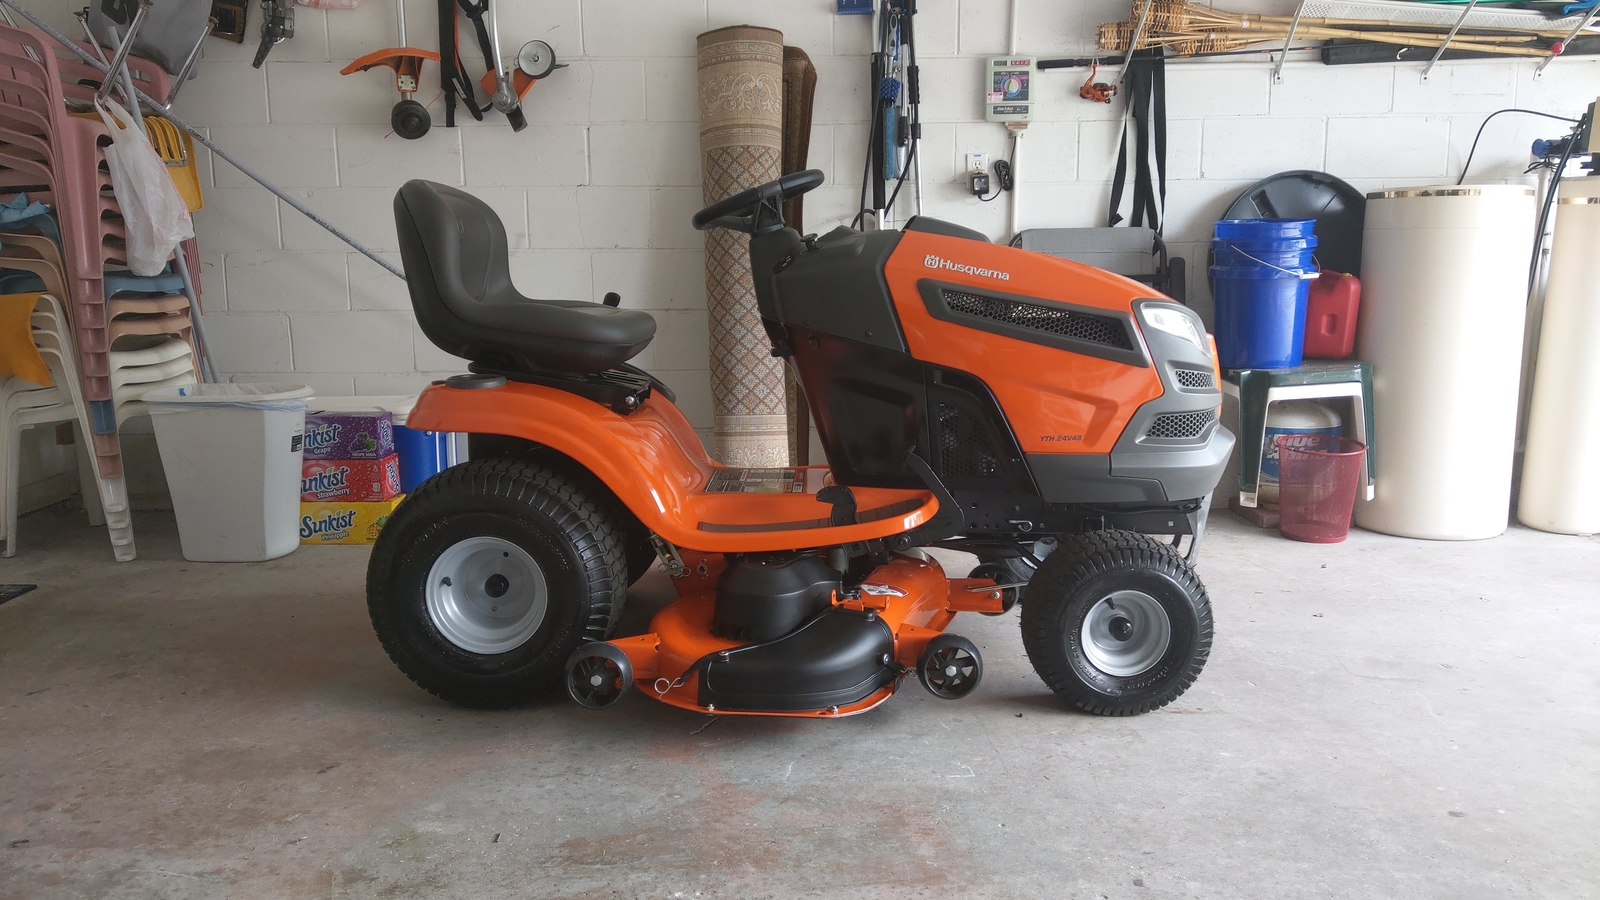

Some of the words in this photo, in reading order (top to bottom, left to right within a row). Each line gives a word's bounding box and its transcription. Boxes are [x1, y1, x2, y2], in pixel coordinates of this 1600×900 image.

[939, 258, 1010, 281] Husqvarna
[304, 424, 341, 447] nkist
[1056, 434, 1083, 442] 24V48
[300, 467, 349, 492] unkist
[317, 488, 350, 498] Strawberry
[300, 510, 356, 538] Sunkist
[321, 531, 348, 540] Pineapple
